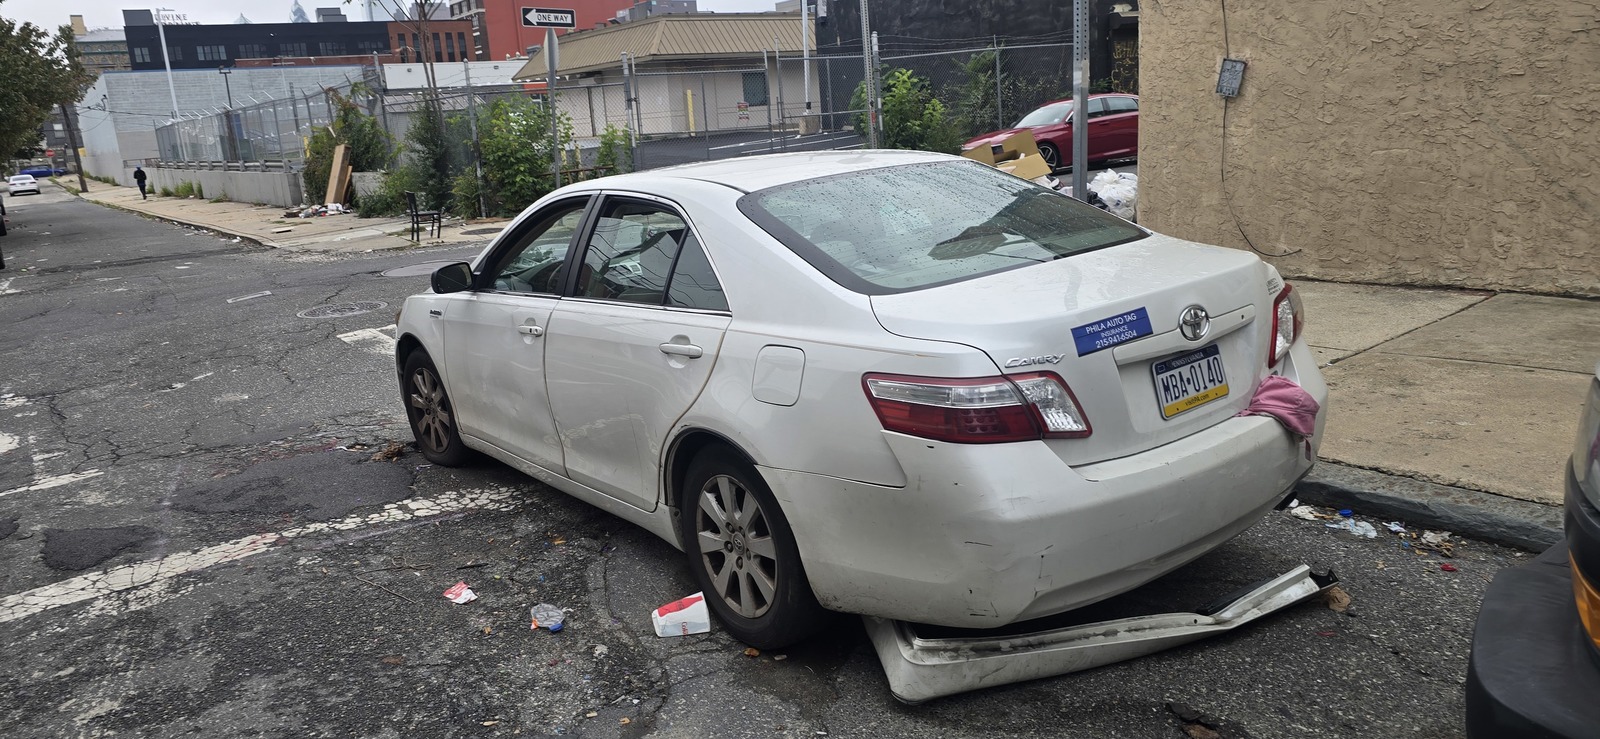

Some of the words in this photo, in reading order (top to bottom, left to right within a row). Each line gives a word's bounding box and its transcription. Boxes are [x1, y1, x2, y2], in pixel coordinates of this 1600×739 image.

[536, 13, 552, 22] ONE
[552, 14, 569, 22] WAY
[1085, 323, 1106, 335] PHILA
[1106, 316, 1124, 328] AUTO
[1123, 312, 1137, 322] TAG
[1095, 329, 1138, 349] 215-941-6504
[1100, 325, 1129, 338] INSURANCE
[1004, 353, 1067, 368] CAMRY
